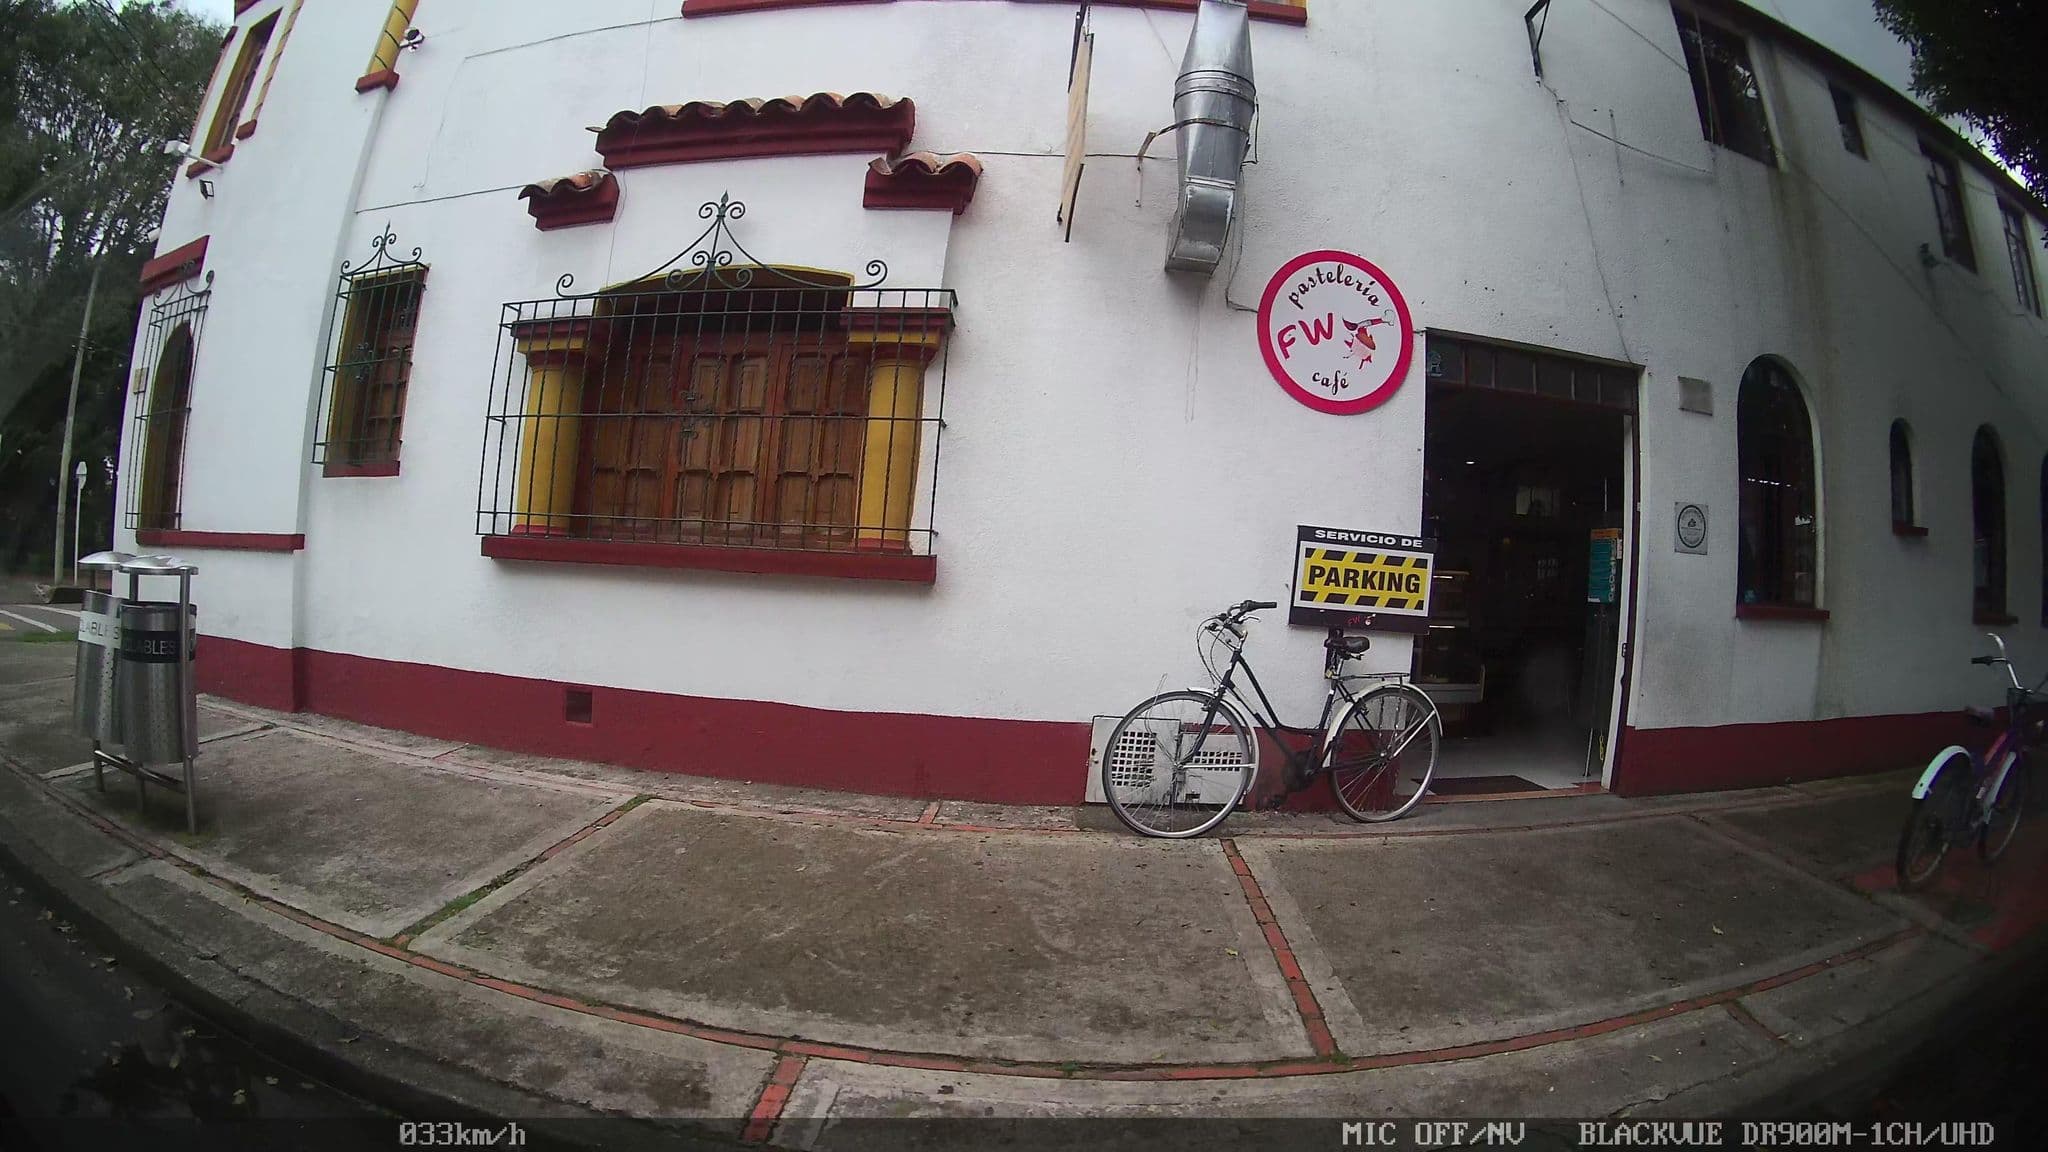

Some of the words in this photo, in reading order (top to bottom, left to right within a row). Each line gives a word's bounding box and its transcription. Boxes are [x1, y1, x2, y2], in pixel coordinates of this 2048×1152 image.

[1288, 264, 1381, 309] pastelería
[1277, 313, 1334, 360] FW
[1312, 371, 1350, 396] café
[1314, 529, 1397, 546] SERVICIO
[1401, 538, 1423, 548] DE
[1308, 565, 1421, 594] PARKING
